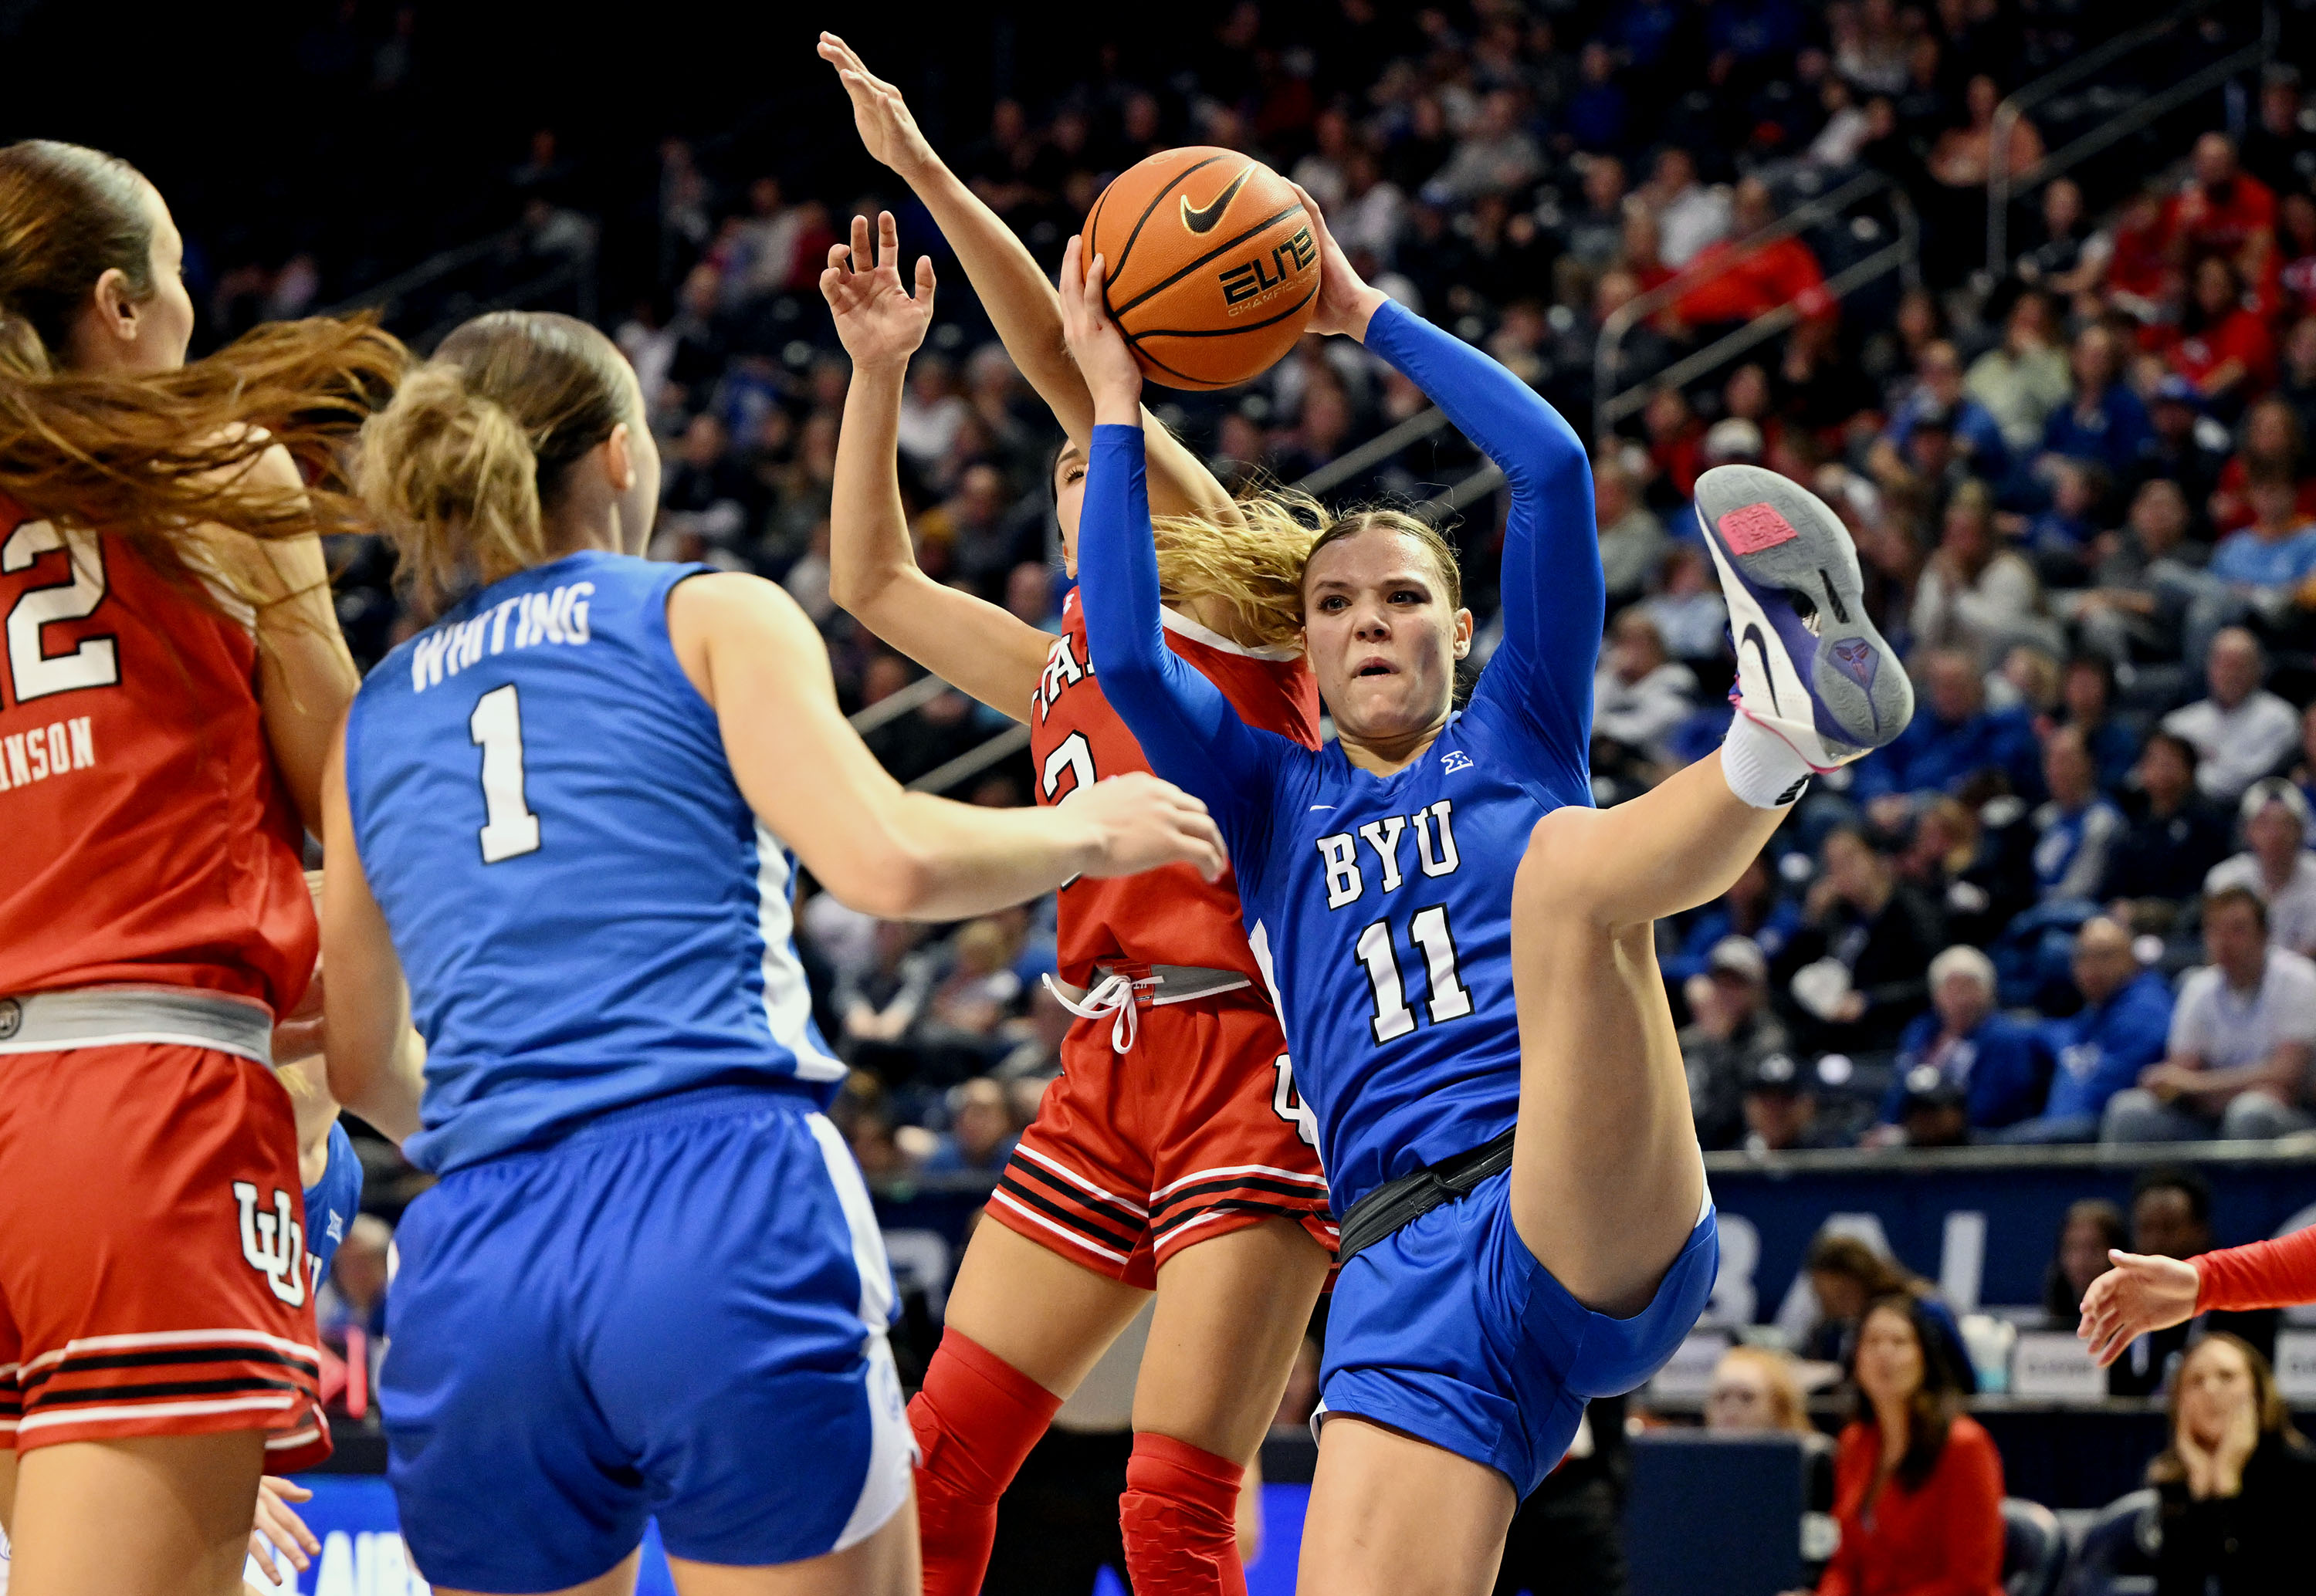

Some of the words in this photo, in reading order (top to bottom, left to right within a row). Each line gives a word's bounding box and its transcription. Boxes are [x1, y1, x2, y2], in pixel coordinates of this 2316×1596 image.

[1218, 225, 1316, 306] ELITE
[0, 518, 122, 705] 2
[411, 581, 595, 693] WHITING
[469, 681, 541, 864] 1
[1315, 798, 1461, 912] BYU
[1353, 901, 1475, 1048] 11
